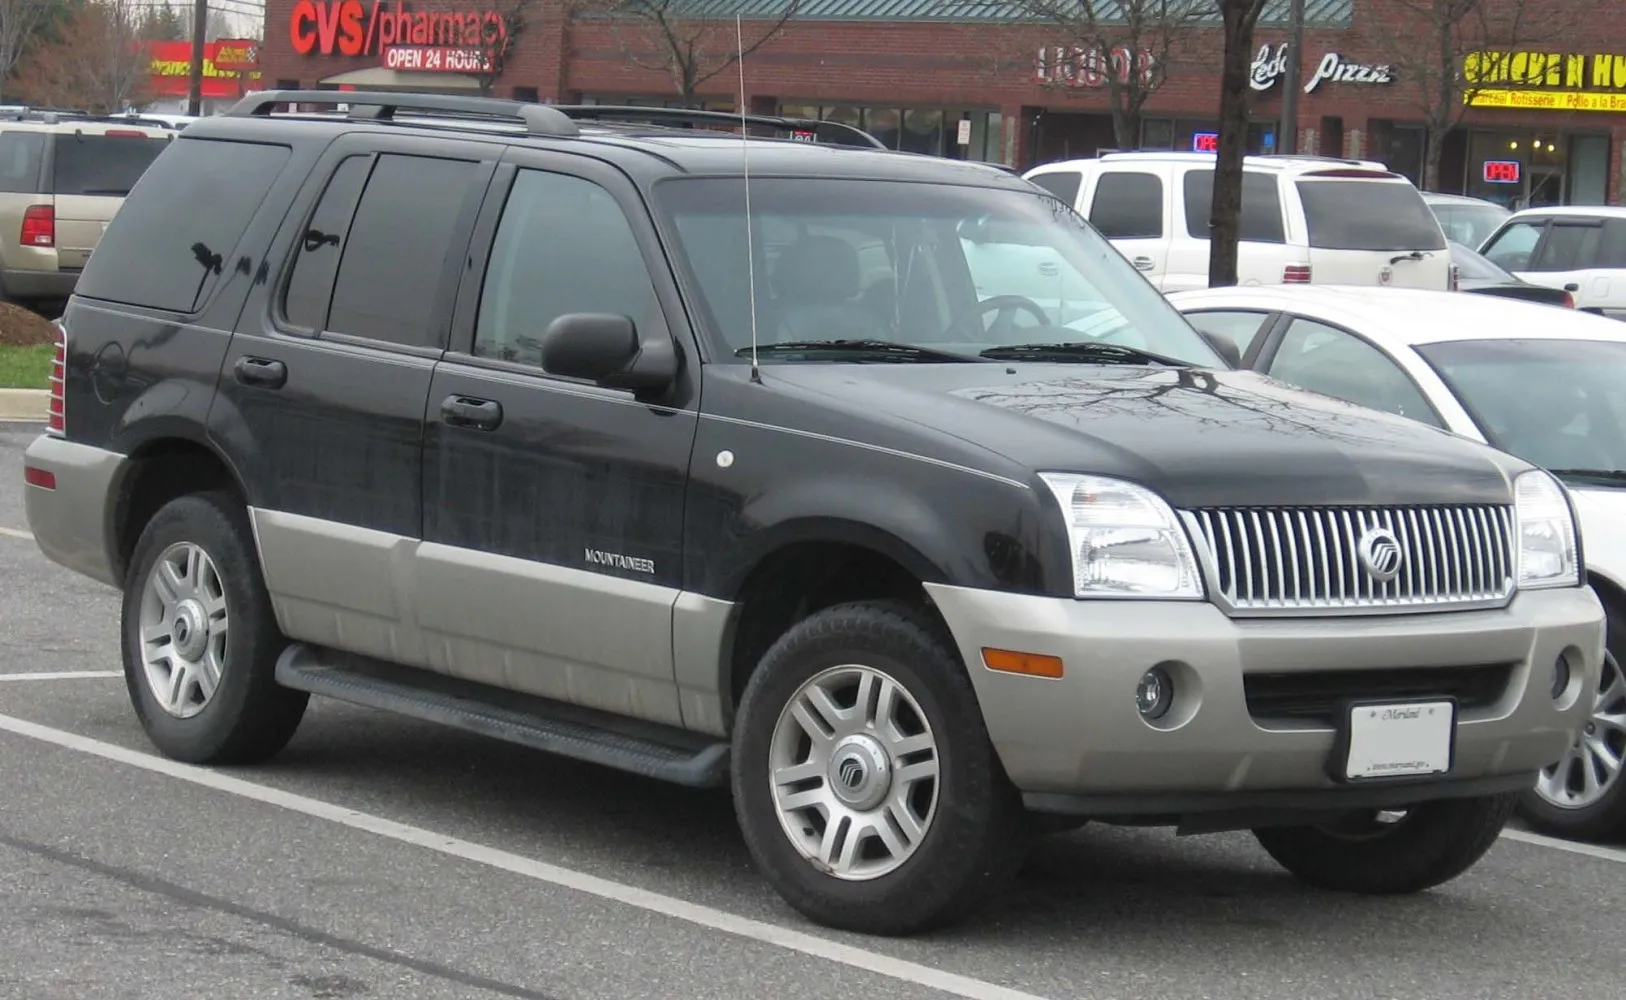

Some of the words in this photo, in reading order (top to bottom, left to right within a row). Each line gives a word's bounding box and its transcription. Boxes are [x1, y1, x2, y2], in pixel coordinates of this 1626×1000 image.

[387, 48, 422, 68] OPEN
[425, 49, 441, 68] 24
[1303, 52, 1391, 94] Pizza
[1463, 51, 1585, 89] CHICKEN
[1567, 94, 1590, 108] Pollo
[1196, 135, 1218, 151] OPE
[1486, 163, 1517, 180] OPEN
[584, 548, 655, 574] MOUNTAINEER
